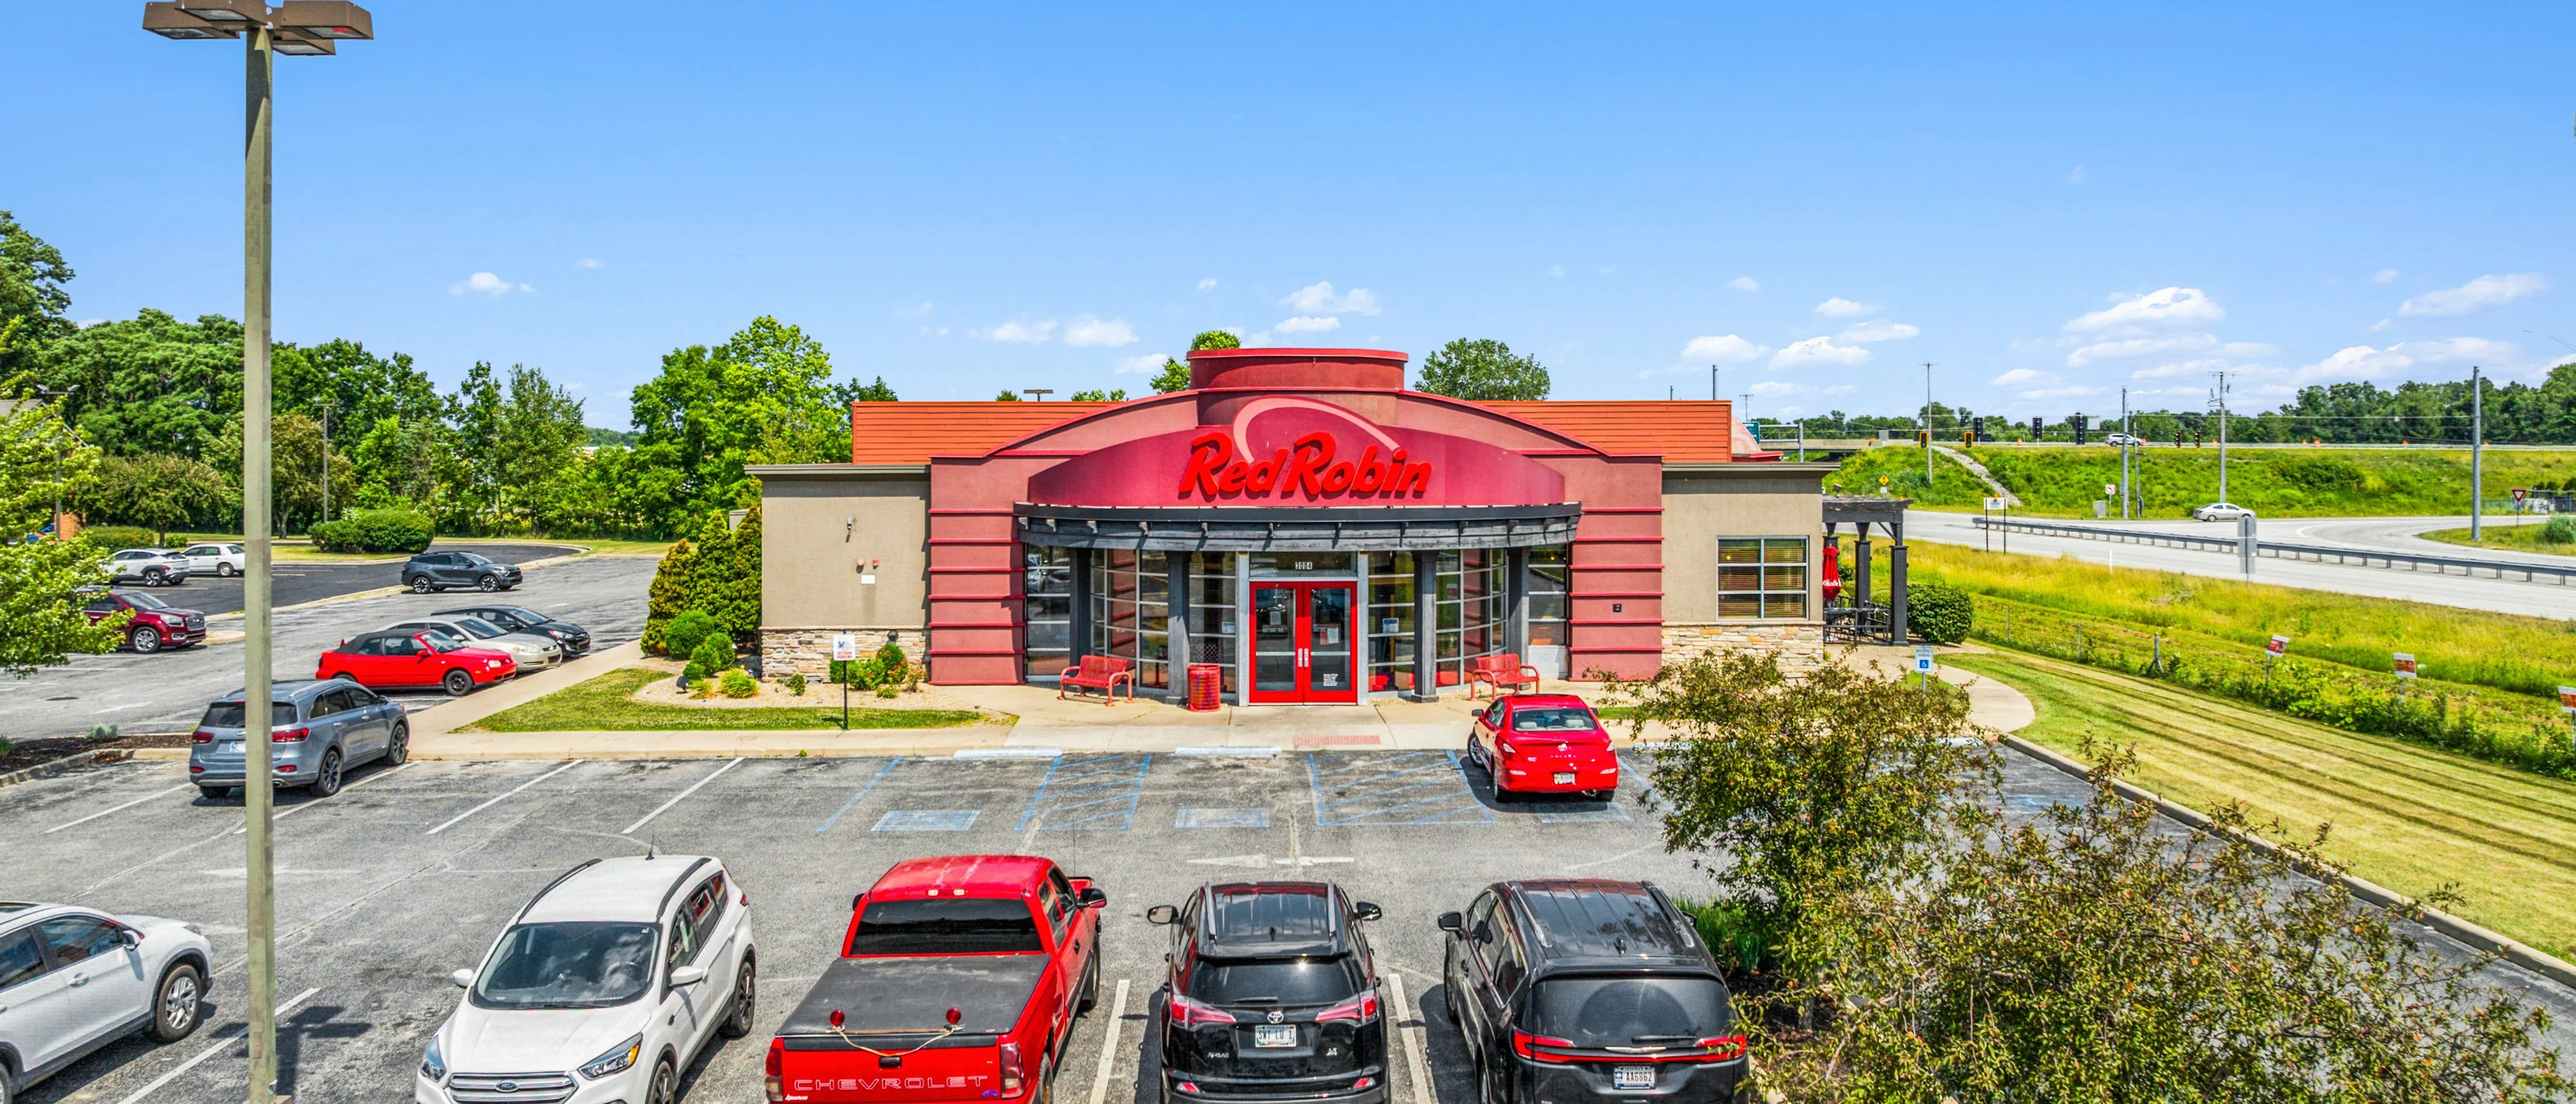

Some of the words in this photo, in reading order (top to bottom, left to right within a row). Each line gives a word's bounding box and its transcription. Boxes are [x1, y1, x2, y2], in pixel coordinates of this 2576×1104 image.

[1178, 432, 1289, 496] Red
[1281, 432, 1432, 496] Robin
[794, 1075, 988, 1091] CHEVROLET
